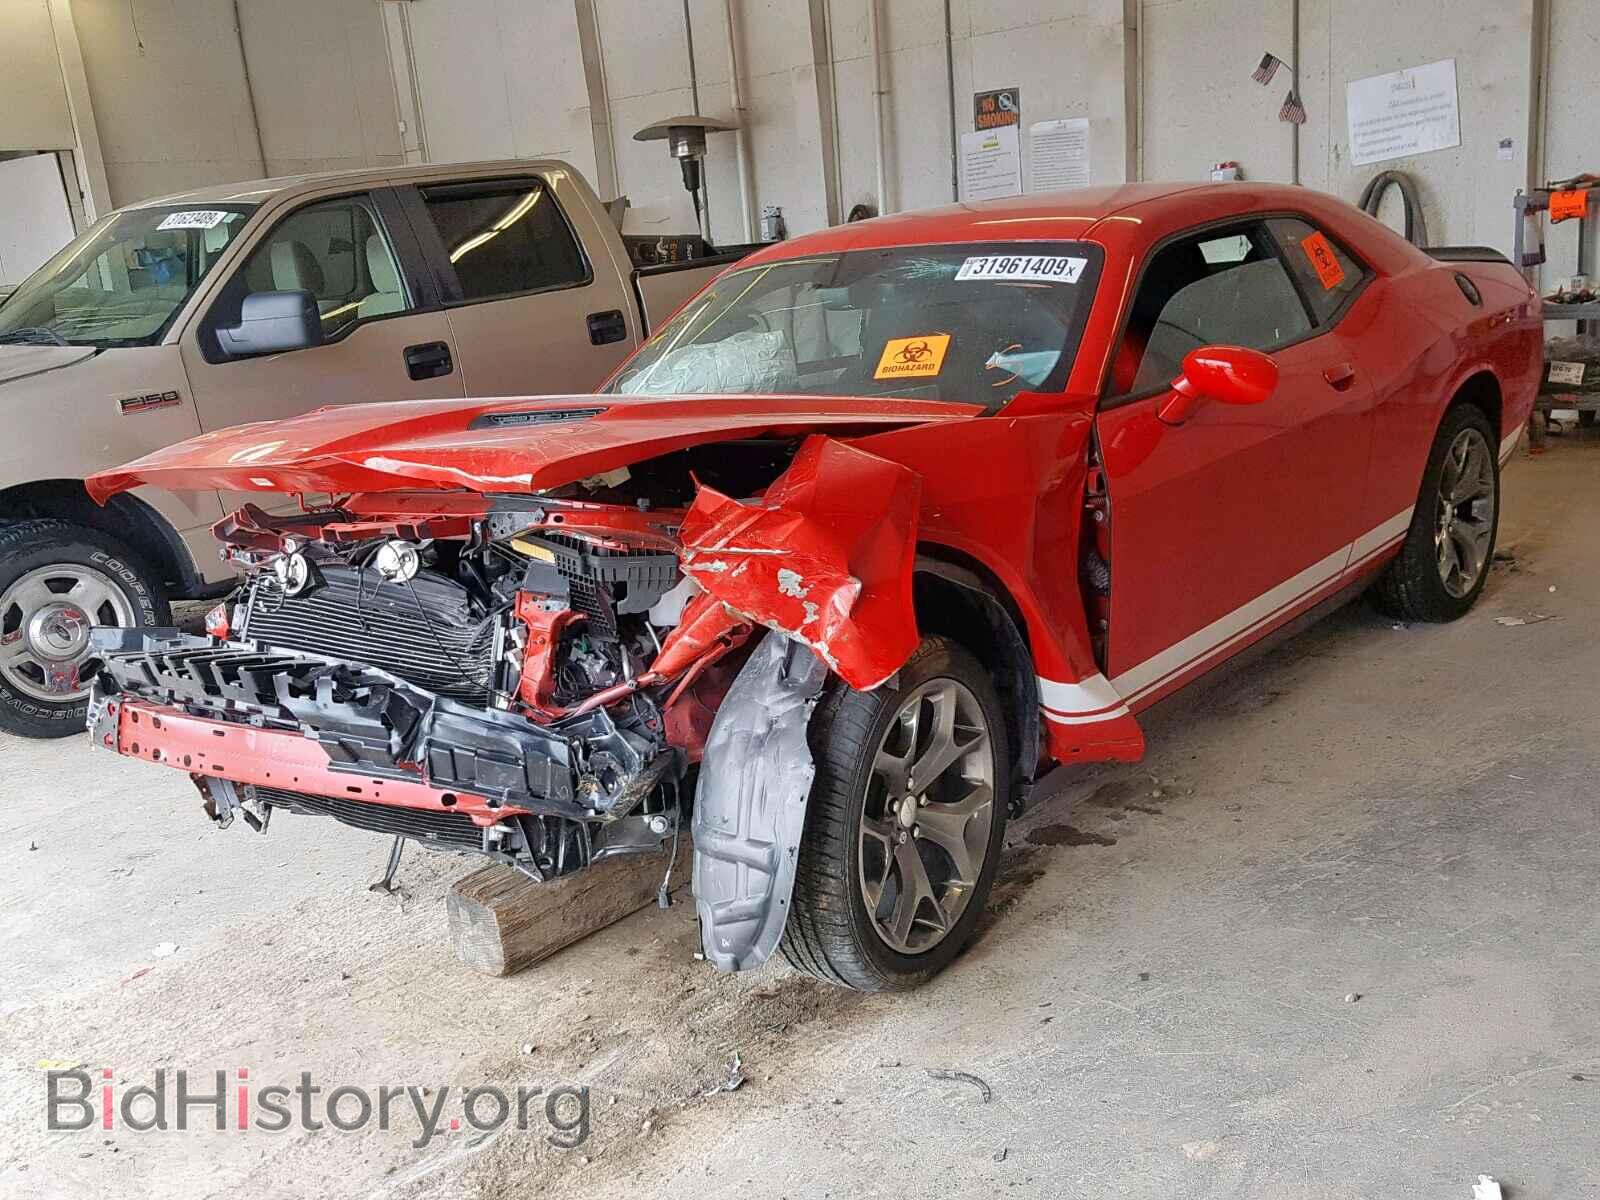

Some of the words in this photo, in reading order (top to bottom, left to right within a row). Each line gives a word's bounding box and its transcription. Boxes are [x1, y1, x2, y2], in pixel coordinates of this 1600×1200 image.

[982, 98, 995, 113] NO
[976, 111, 1018, 129] SMOKING
[881, 363, 936, 374] BIOHAZARD
[90, 551, 155, 626] COOPER
